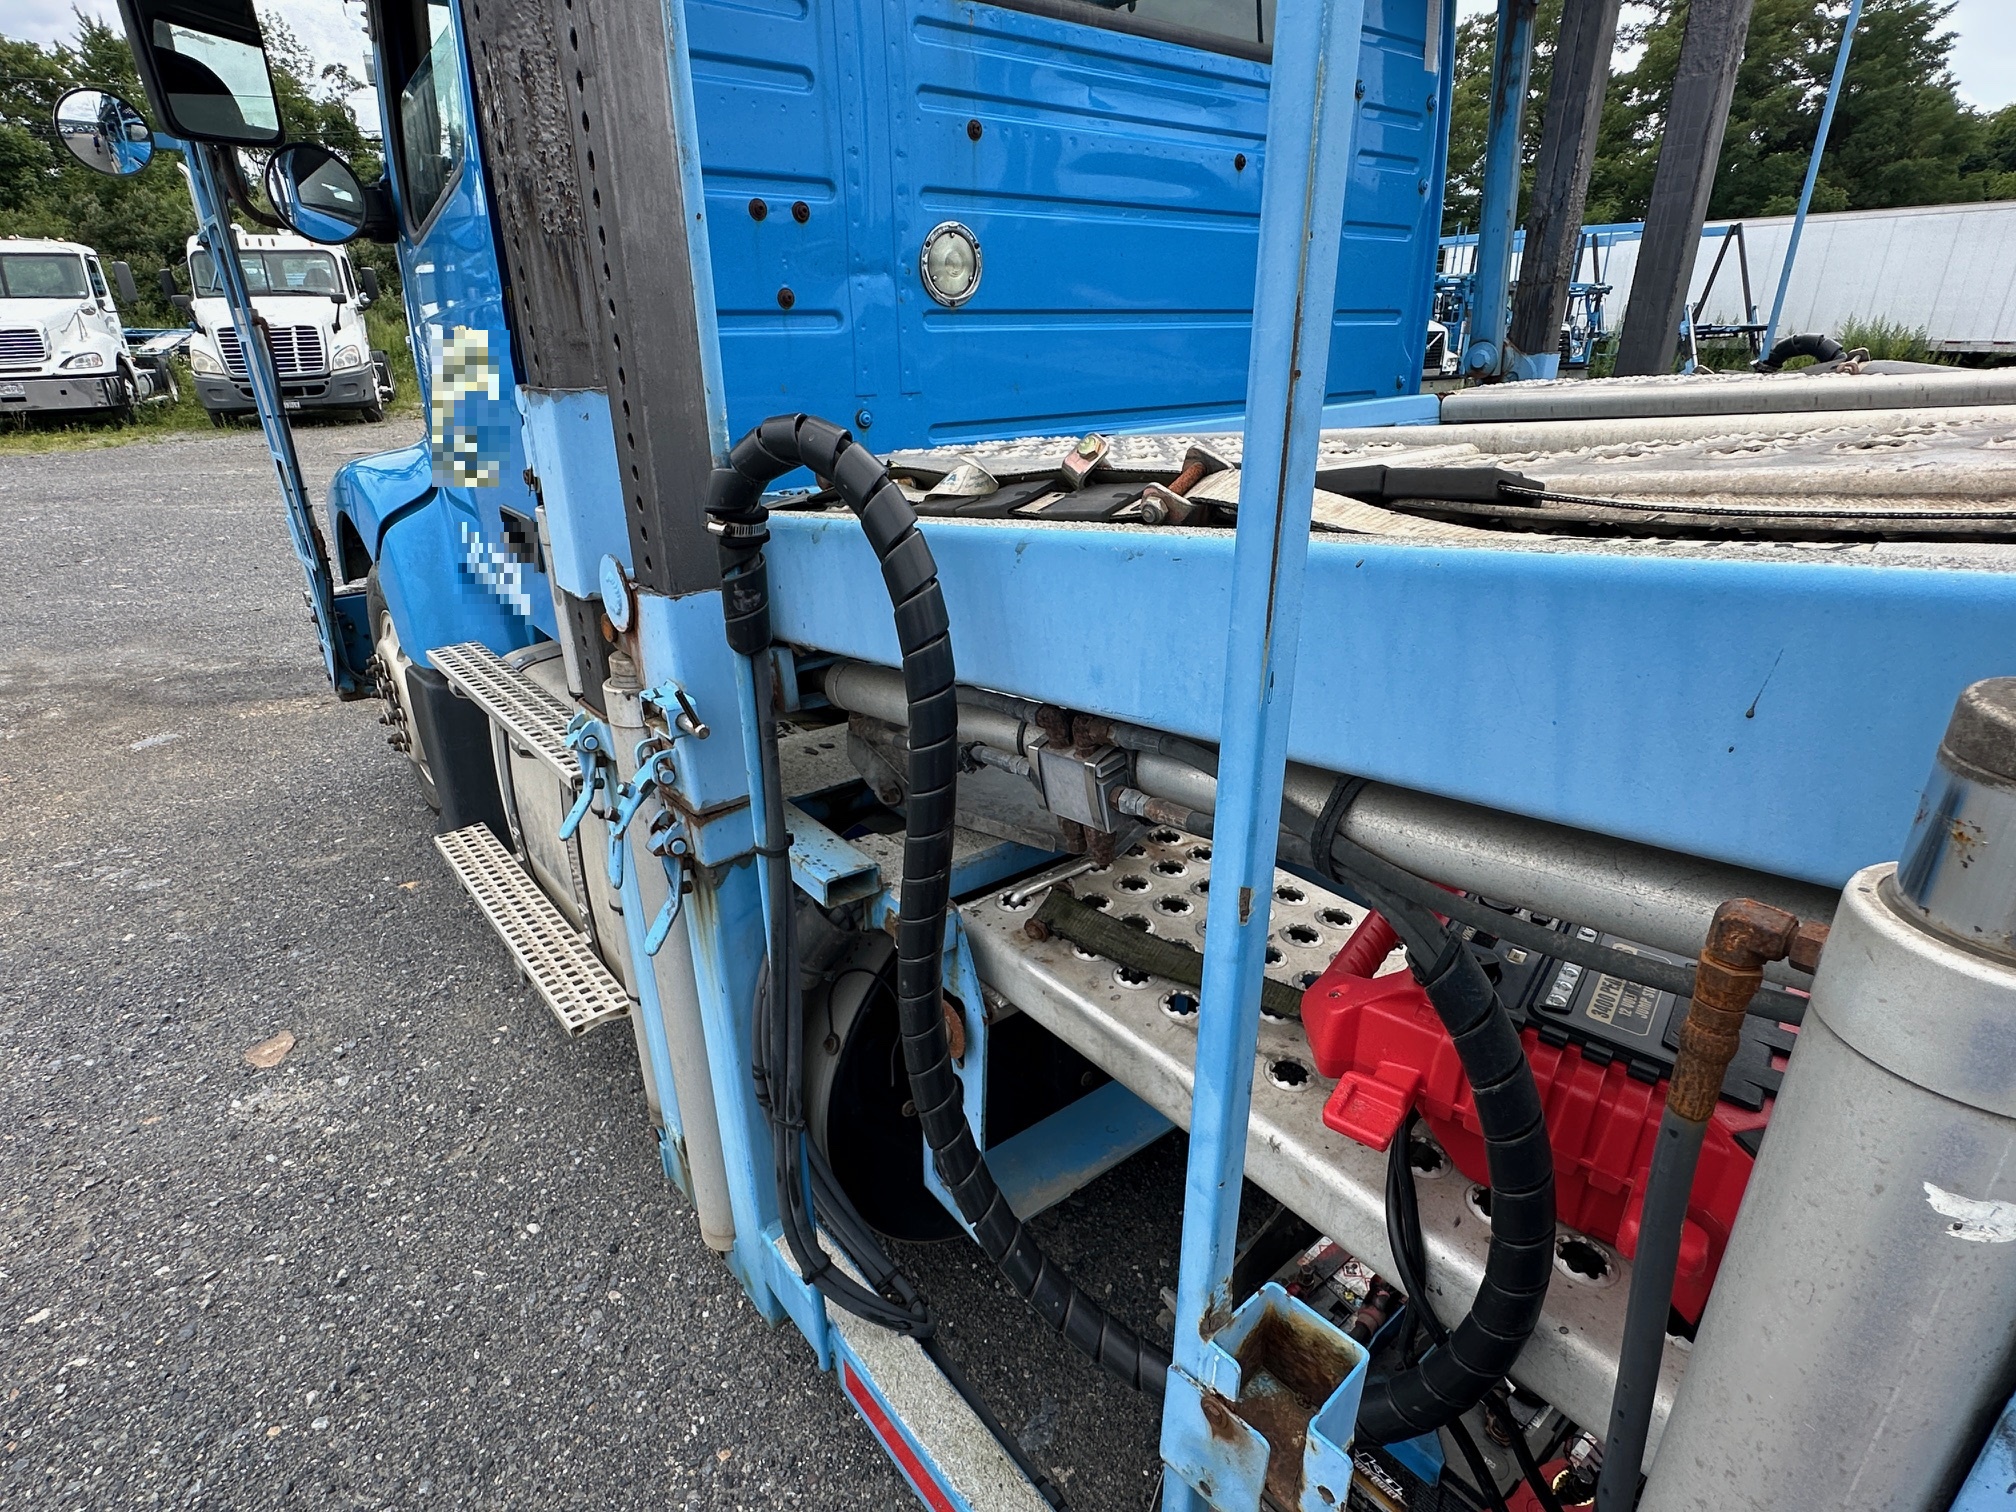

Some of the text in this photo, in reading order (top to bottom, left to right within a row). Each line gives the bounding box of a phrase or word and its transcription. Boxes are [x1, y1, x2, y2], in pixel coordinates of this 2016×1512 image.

[1591, 977, 1623, 1018] 3400 PEA
[1621, 991, 1637, 1008] VOLT
[1618, 1007, 1631, 1017] 12
[1635, 997, 1651, 1019] JUMP
